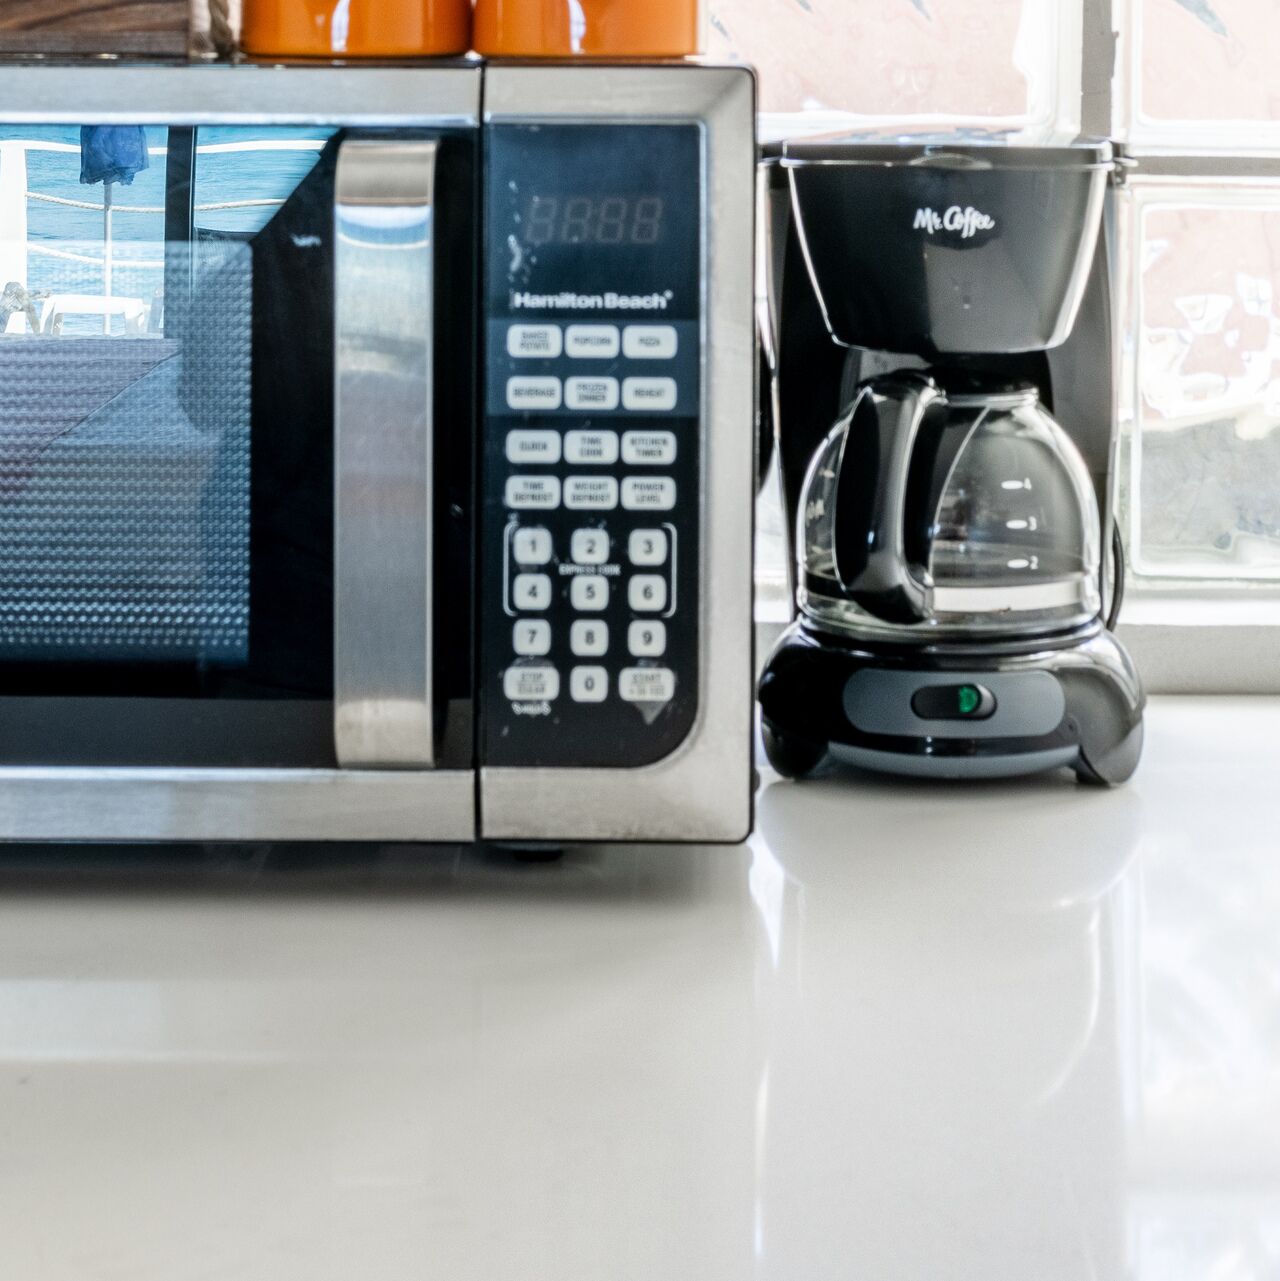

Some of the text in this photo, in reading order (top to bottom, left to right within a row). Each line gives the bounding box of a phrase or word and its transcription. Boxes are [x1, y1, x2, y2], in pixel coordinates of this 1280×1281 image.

[943, 205, 996, 239] Coffee
[513, 291, 603, 309] Hamilton
[530, 539, 537, 552] 1
[586, 539, 596, 554] 2
[643, 539, 653, 554] 3
[1030, 555, 1039, 570] 2
[528, 585, 538, 598] 4
[586, 584, 595, 599] 5
[643, 585, 653, 600] 6
[528, 630, 537, 644] 7
[585, 630, 595, 646] 8
[643, 631, 653, 646] 9
[584, 676, 595, 692] 0
